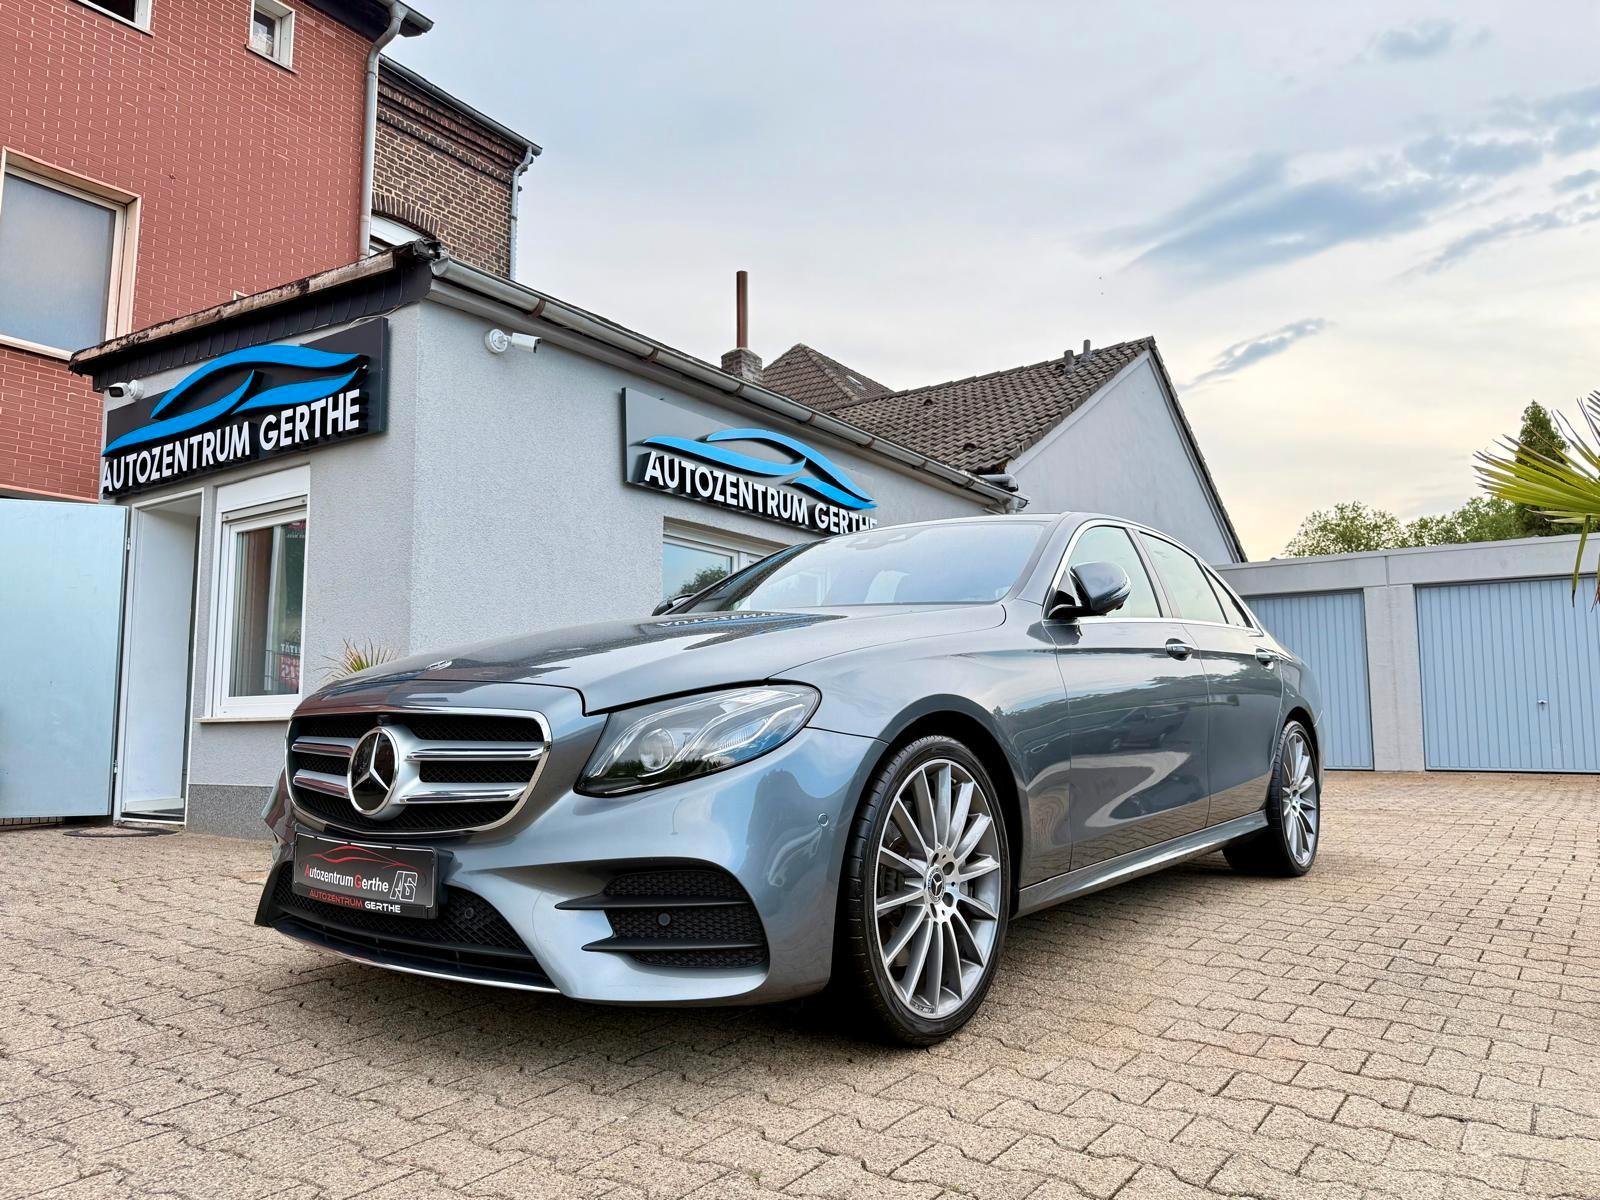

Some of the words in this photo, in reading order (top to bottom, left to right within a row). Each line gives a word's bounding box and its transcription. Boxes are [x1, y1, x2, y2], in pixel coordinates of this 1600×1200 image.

[101, 421, 250, 493] AUTOZENTRUM
[259, 388, 360, 451] GERTHE
[644, 450, 809, 525] AUTOZENTRUM
[304, 863, 354, 888] Autozentrum
[354, 873, 389, 892] Gerthe
[309, 889, 363, 908] AUTOZENTRUM
[364, 901, 401, 913] GERTHE
